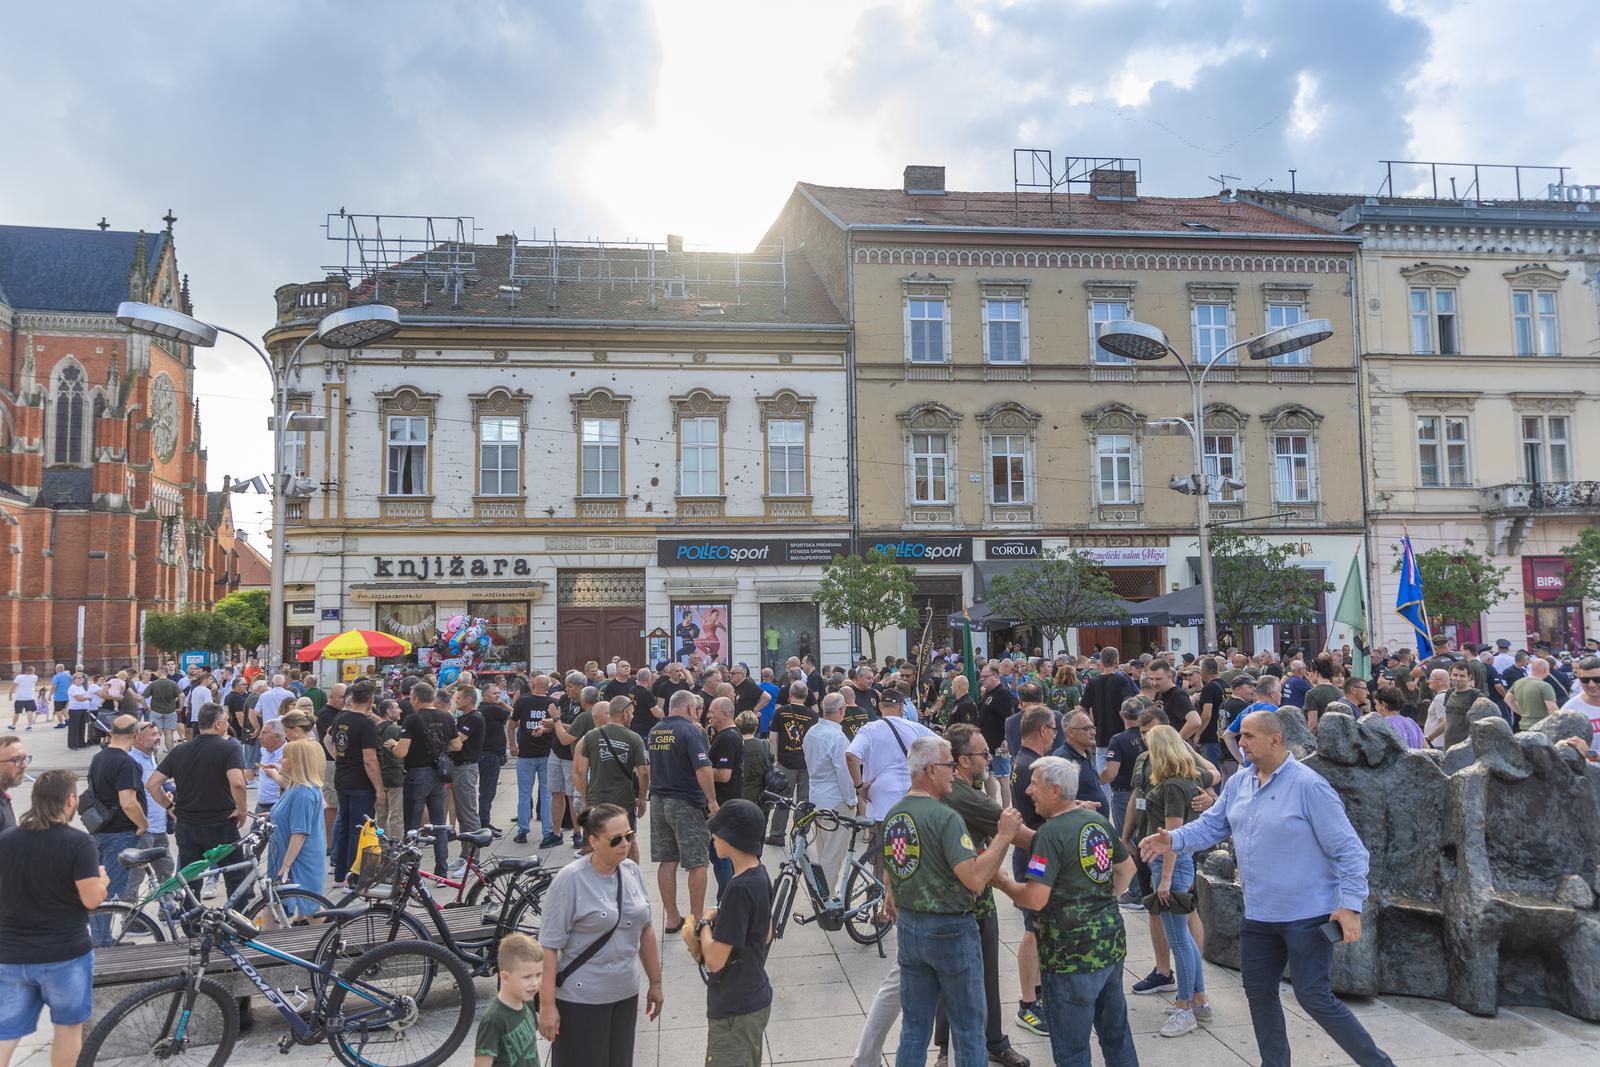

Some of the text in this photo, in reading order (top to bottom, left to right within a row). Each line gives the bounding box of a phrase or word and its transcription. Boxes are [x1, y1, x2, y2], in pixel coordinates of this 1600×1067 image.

[991, 546, 1037, 555] COROLLA
[1122, 550, 1140, 560] salon
[373, 555, 531, 580] knjižara
[1536, 576, 1562, 587] BIPA
[1130, 617, 1149, 626] jana
[530, 710, 547, 719] HOS
[655, 735, 676, 744] GBR
[230, 953, 293, 1013] ROMET
